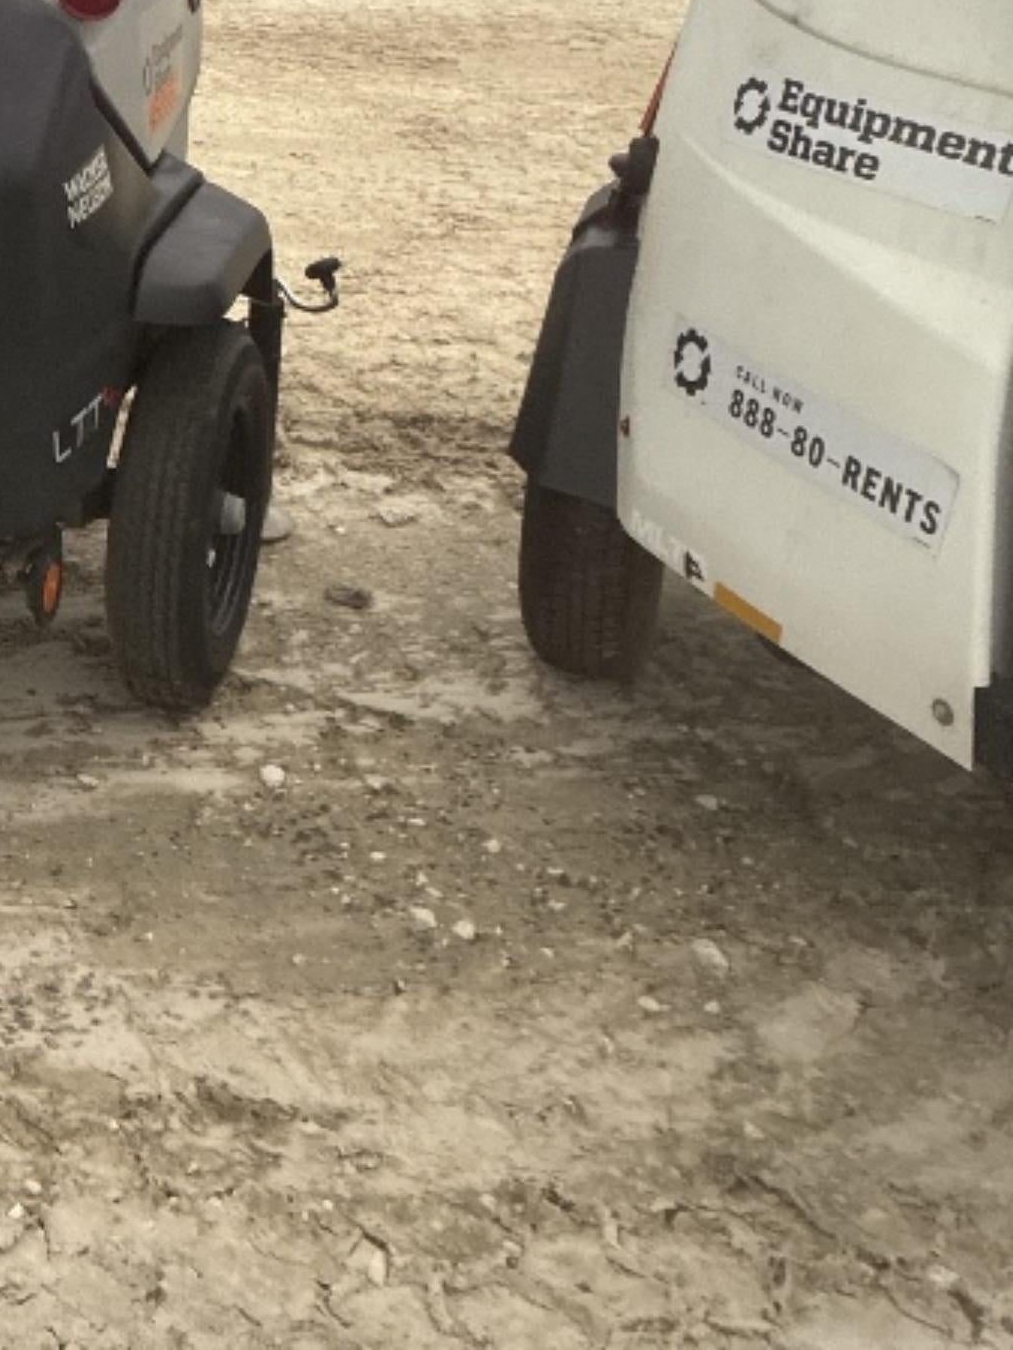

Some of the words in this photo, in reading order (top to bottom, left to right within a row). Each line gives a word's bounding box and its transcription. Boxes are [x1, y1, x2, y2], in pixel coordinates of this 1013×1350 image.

[767, 118, 880, 182] Share
[778, 77, 1013, 178] Equipment
[736, 364, 766, 395] CALL
[772, 384, 804, 415] NOW
[728, 388, 942, 536] 888-80-RENTS
